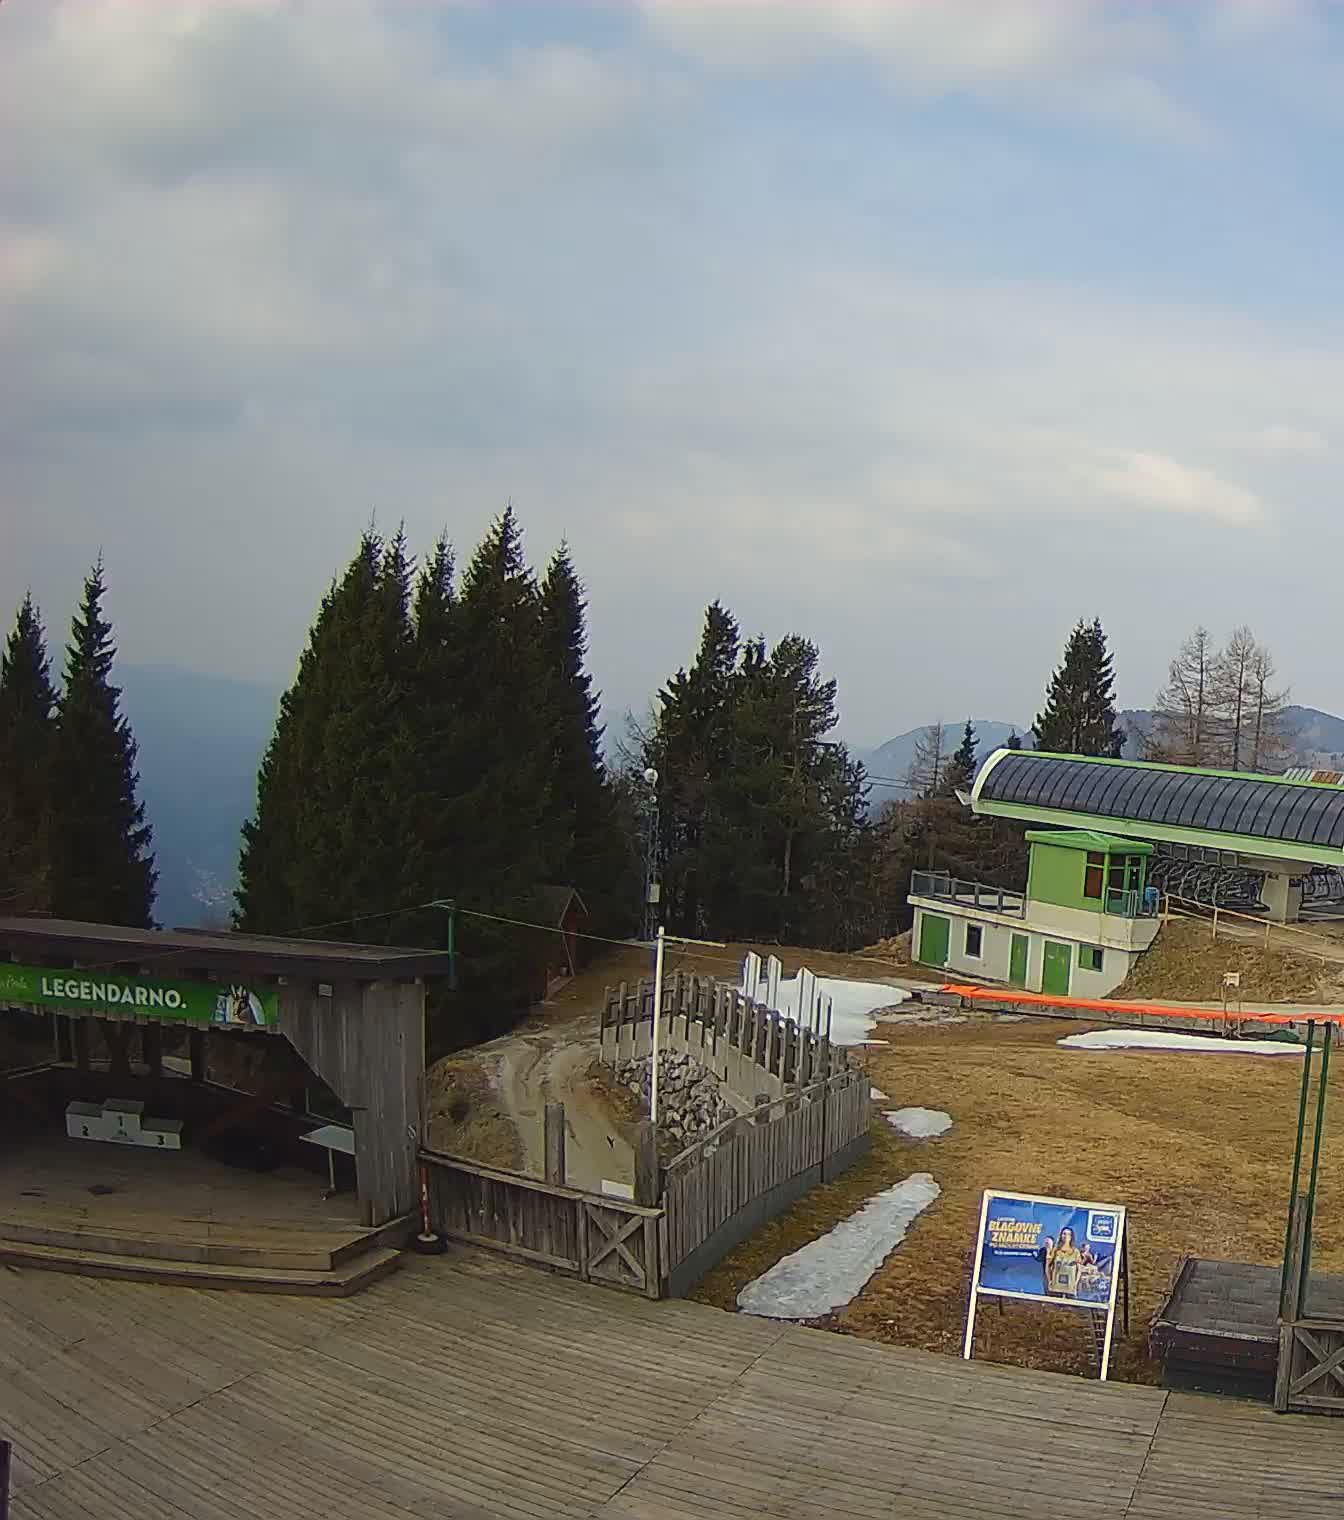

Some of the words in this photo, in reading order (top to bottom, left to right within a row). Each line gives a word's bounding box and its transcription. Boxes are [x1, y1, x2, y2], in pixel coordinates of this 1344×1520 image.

[41, 976, 188, 1010] LEGENDARNO.
[157, 1135, 165, 1146] 3
[991, 1231, 1038, 1244] ZNAMKE
